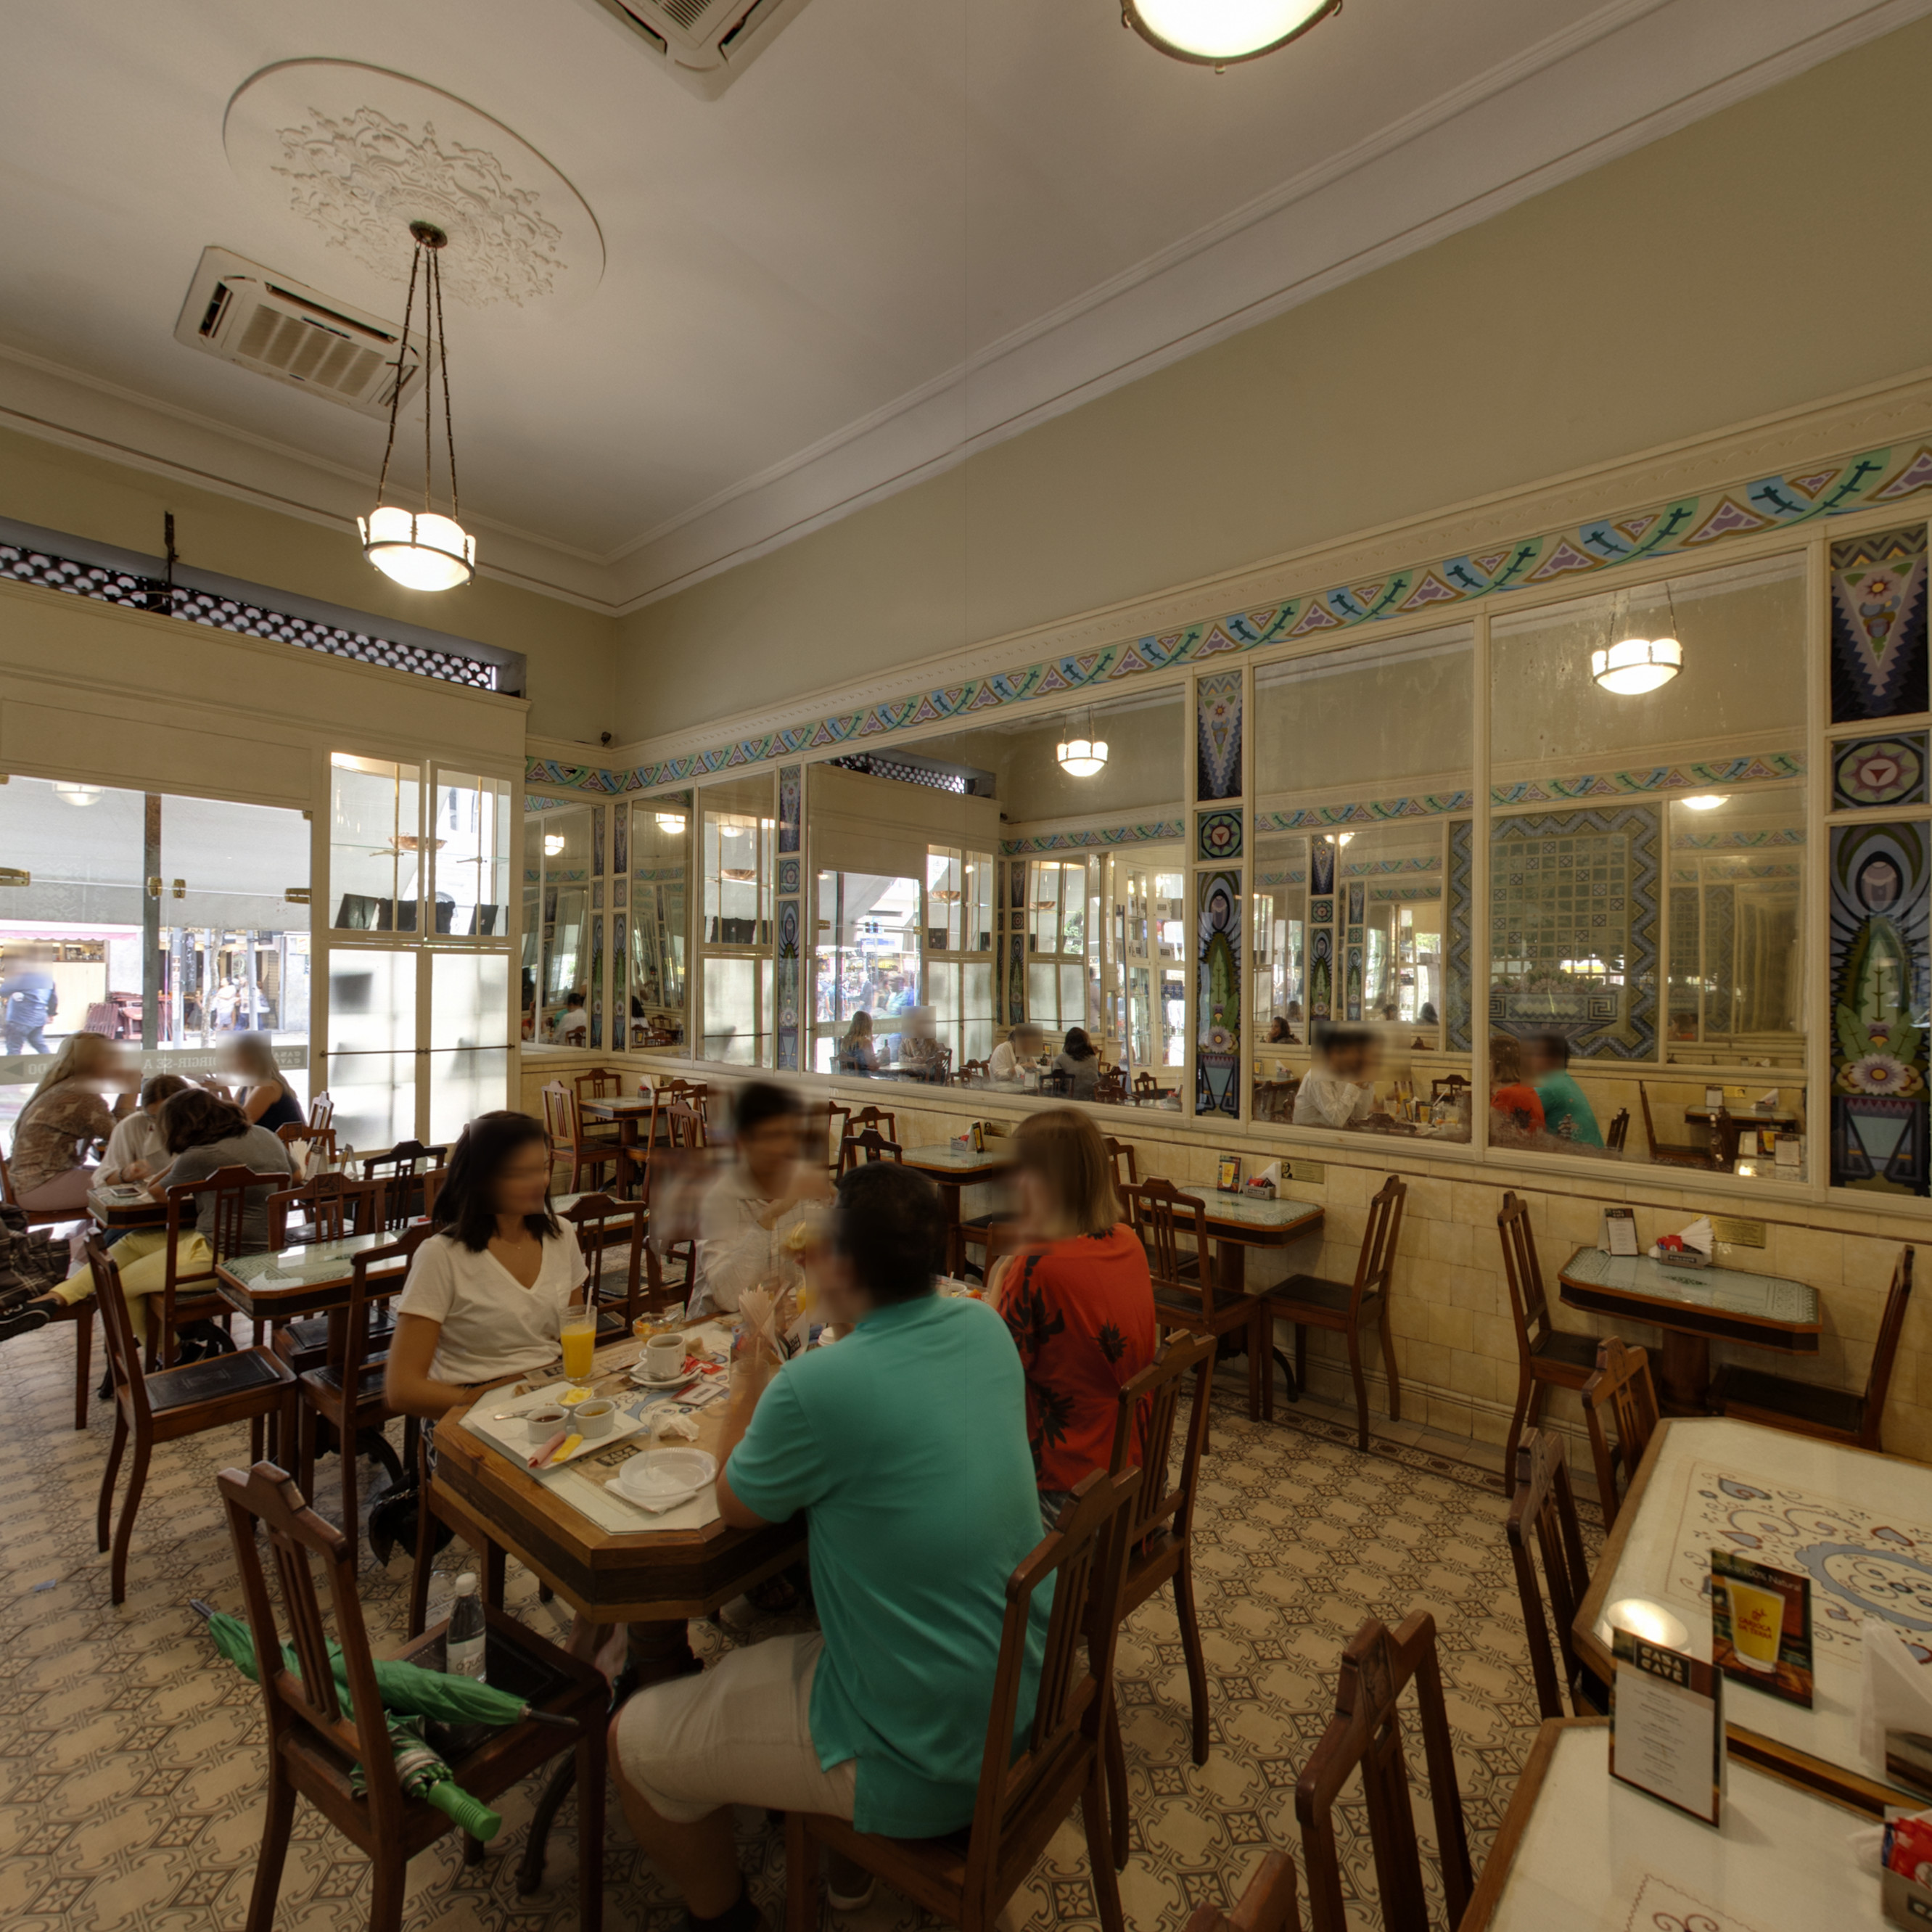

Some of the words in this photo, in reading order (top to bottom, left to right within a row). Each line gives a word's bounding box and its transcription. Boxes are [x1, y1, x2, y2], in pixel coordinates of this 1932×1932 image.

[1743, 1567, 1767, 1582] 100%
[1768, 1574, 1802, 1592] Natural
[1640, 1646, 1682, 1672] CASA
